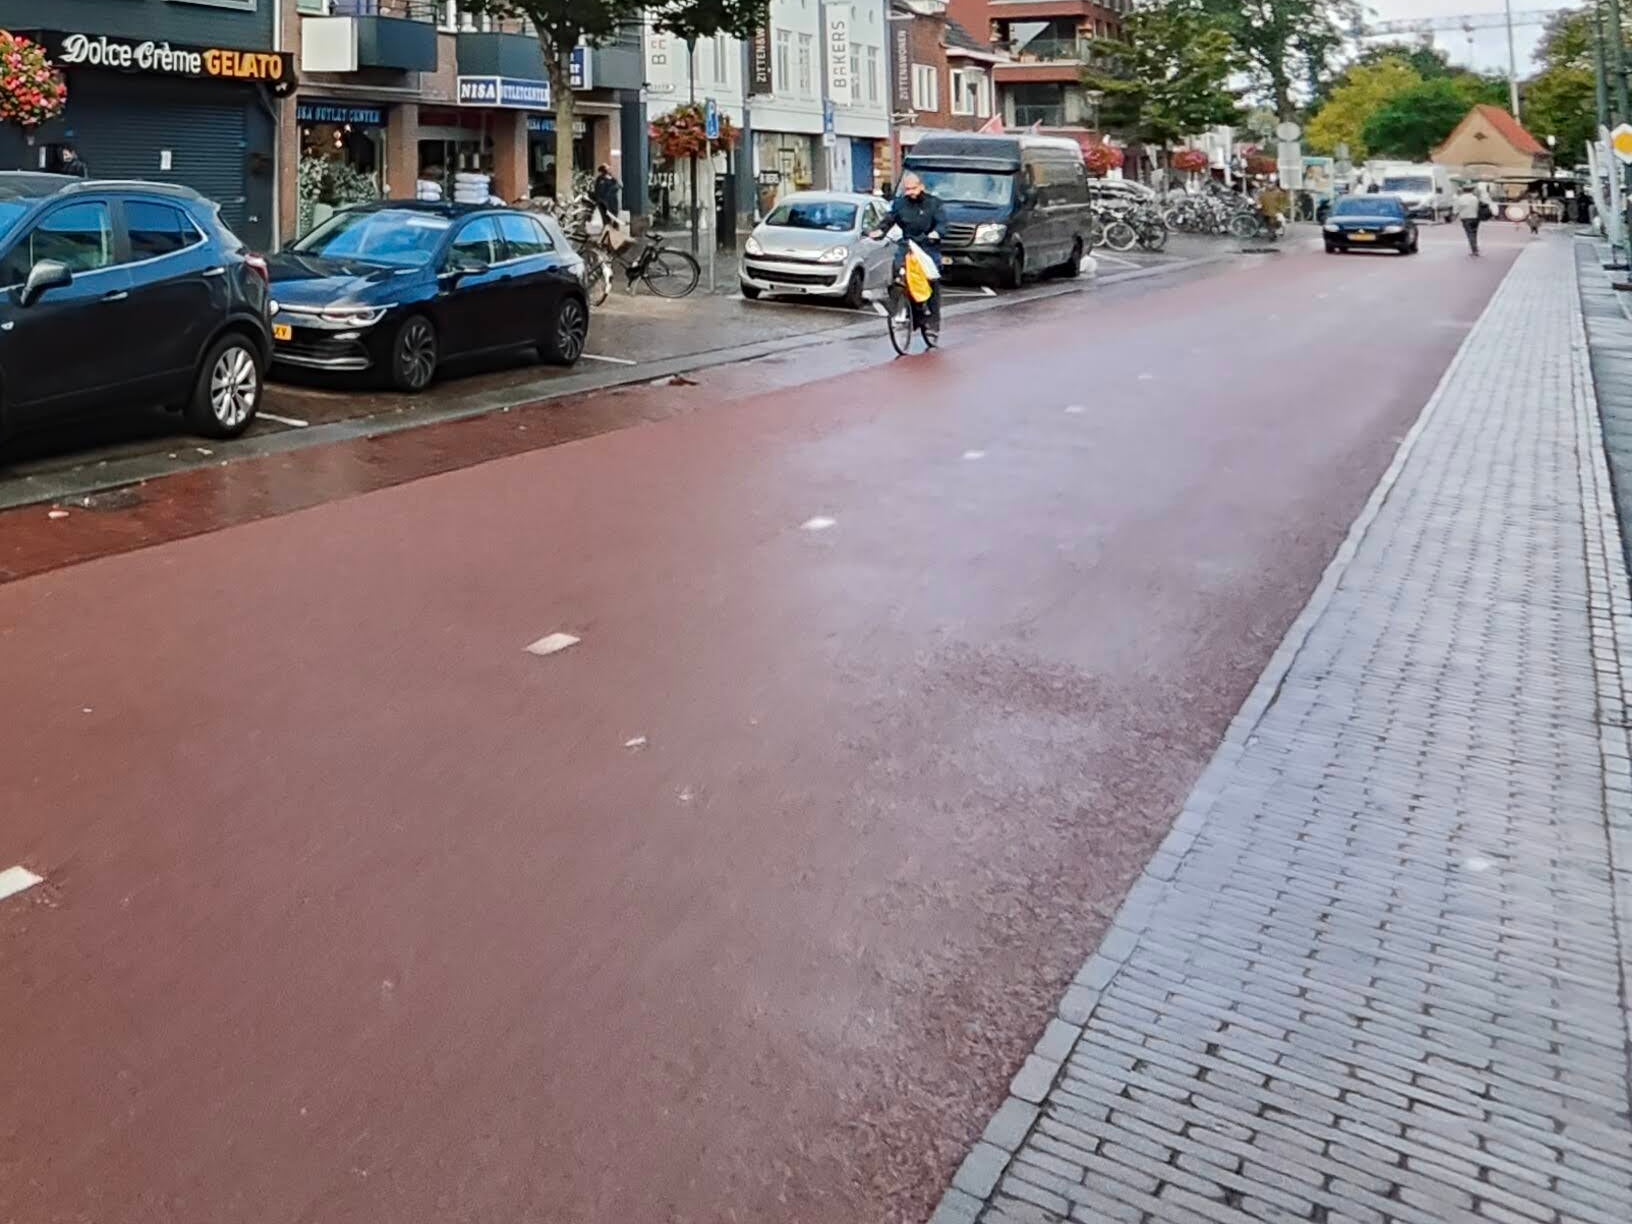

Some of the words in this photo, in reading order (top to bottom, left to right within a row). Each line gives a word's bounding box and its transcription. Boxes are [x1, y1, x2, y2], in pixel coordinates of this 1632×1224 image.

[58, 33, 132, 68] Dolce
[133, 40, 202, 74] Crème
[203, 48, 283, 80] GELATO
[831, 20, 848, 88] BAKERS
[460, 83, 496, 99] NISA
